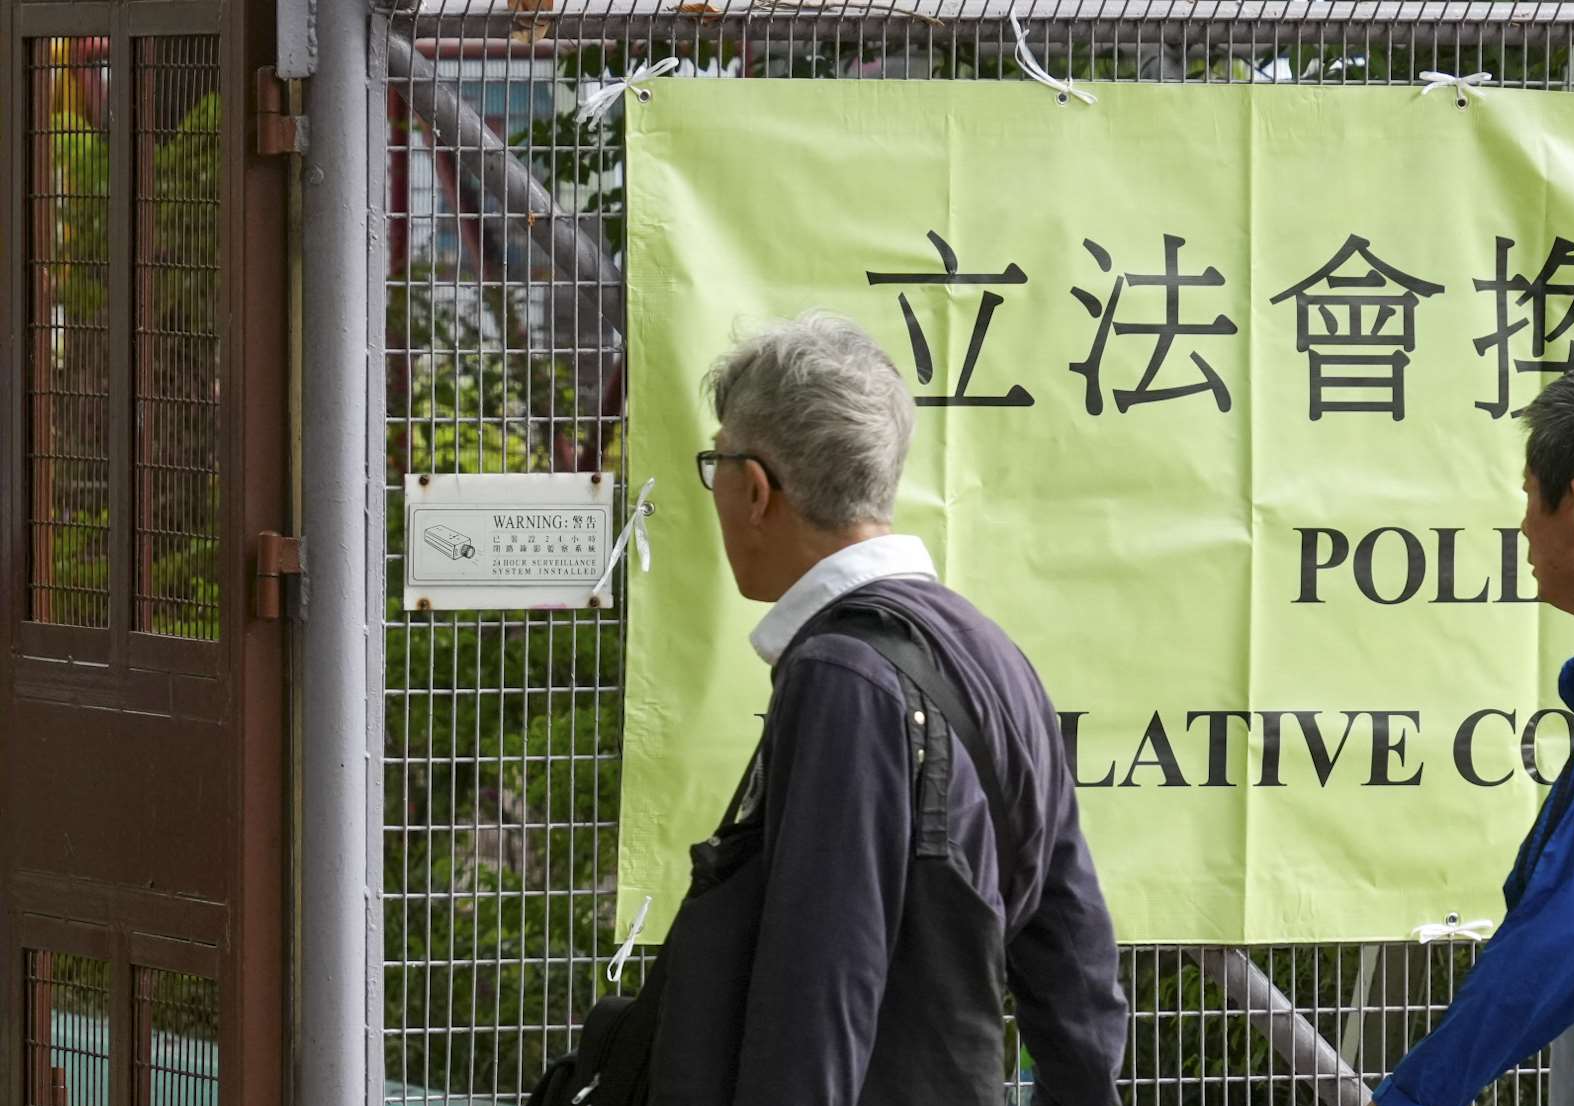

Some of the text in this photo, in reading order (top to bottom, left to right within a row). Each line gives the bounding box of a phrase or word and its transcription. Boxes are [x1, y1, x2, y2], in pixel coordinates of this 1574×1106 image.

[493, 514, 568, 529] WARNING:
[503, 559, 527, 567] HOUR
[532, 559, 597, 567] SURVEILLANCE
[492, 567, 597, 576] SYSTEM INSTALLED
